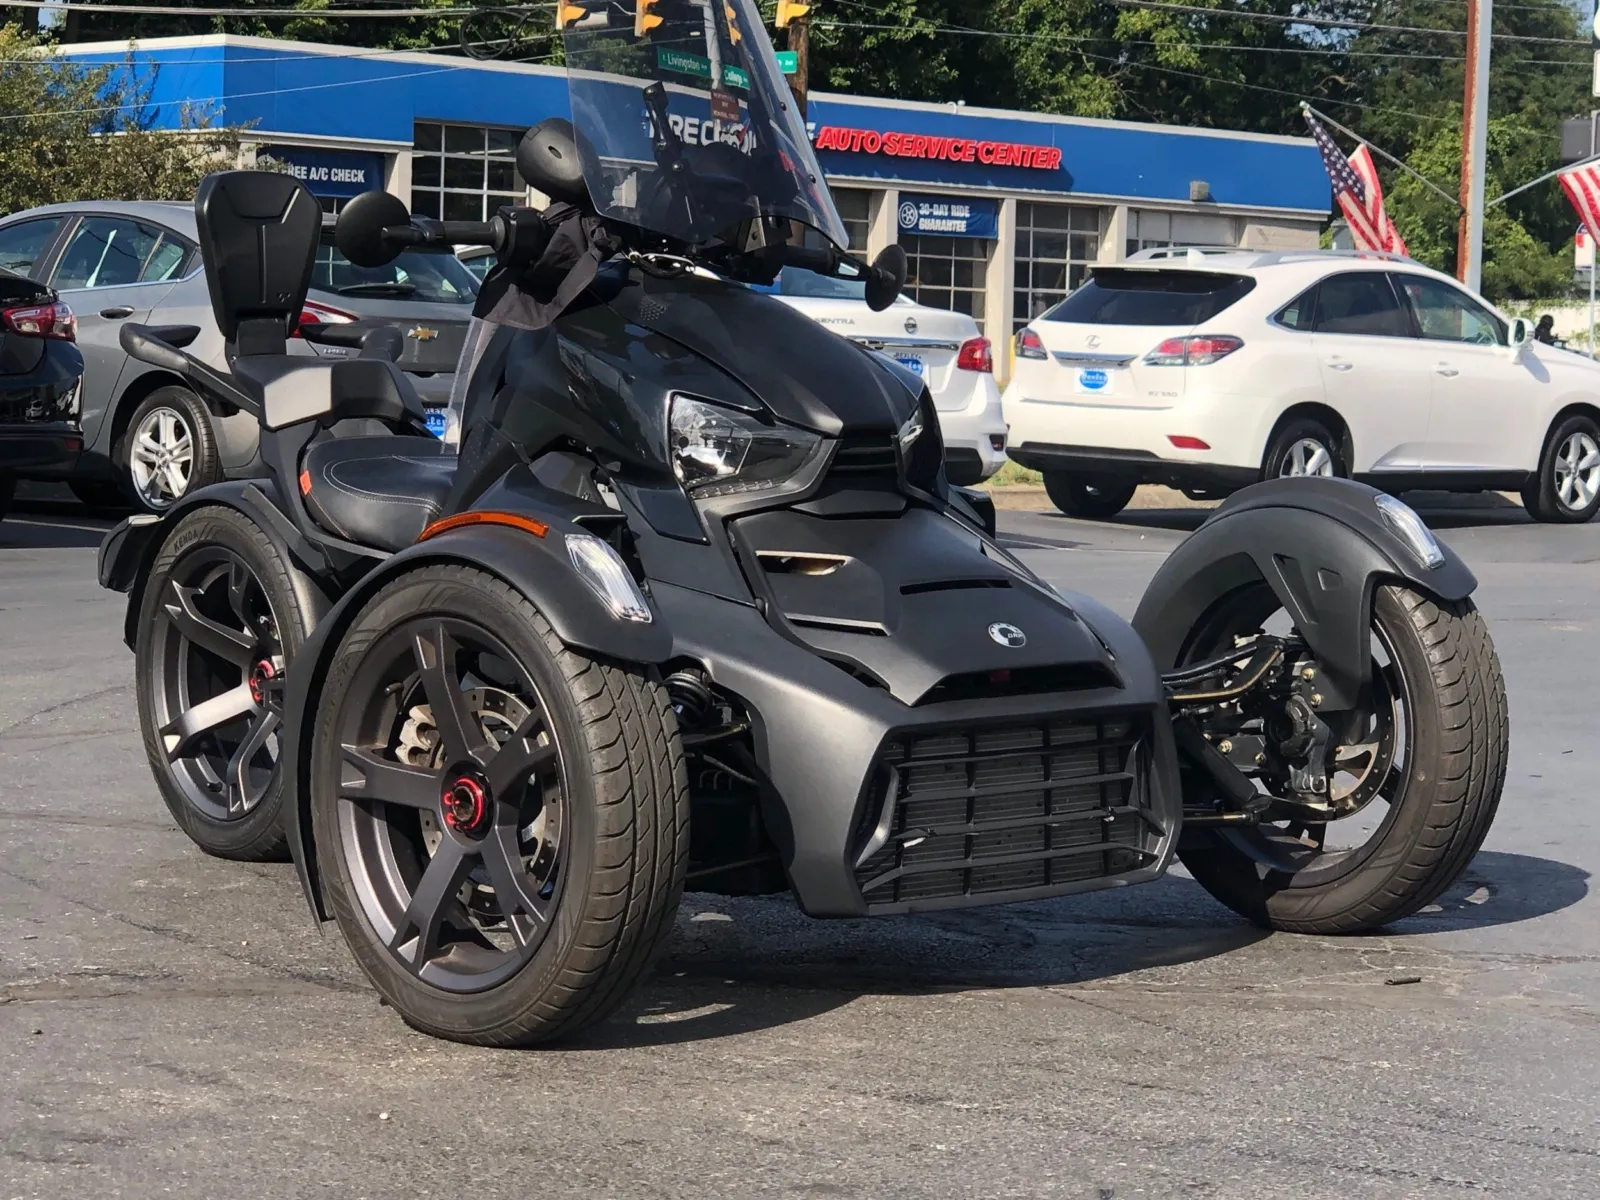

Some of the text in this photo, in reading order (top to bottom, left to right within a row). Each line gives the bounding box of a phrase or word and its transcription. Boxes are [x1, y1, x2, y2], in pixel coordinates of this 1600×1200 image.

[667, 53, 701, 71] Livingston
[816, 126, 1062, 170] AUTO SERVICE CENTER
[309, 167, 329, 181] A/C
[330, 168, 365, 183] CHECK
[919, 203, 970, 218] 30-DAY RIDE
[918, 218, 967, 232] GUARANTEE
[173, 528, 198, 553] KENDA
